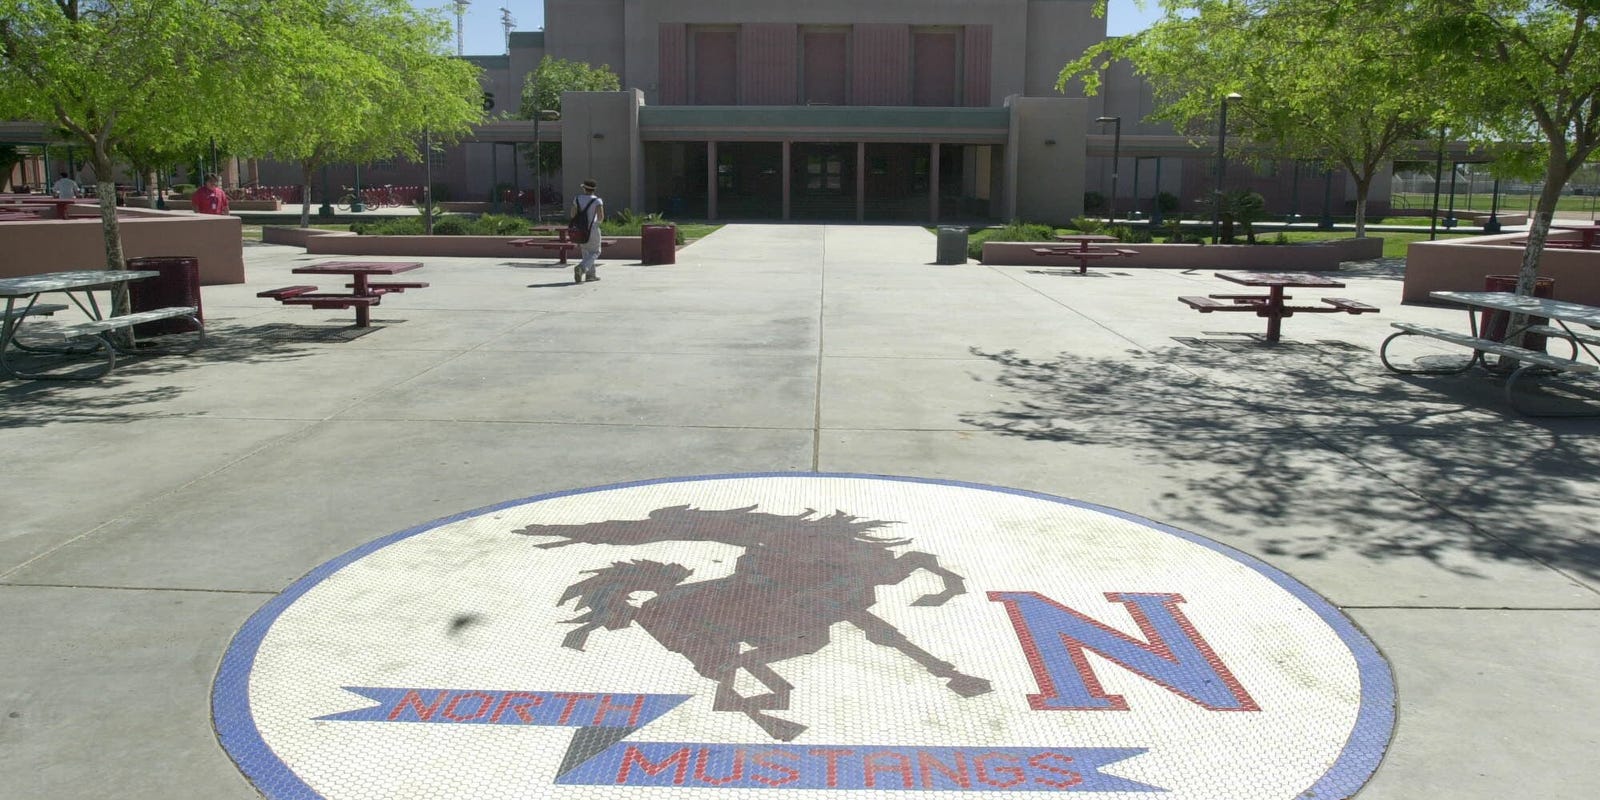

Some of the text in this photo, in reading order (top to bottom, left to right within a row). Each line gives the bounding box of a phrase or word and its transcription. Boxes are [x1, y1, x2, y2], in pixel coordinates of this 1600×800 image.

[986, 591, 1262, 711] N
[388, 690, 645, 726] NORTH
[615, 745, 1083, 788] MUSTANGS
